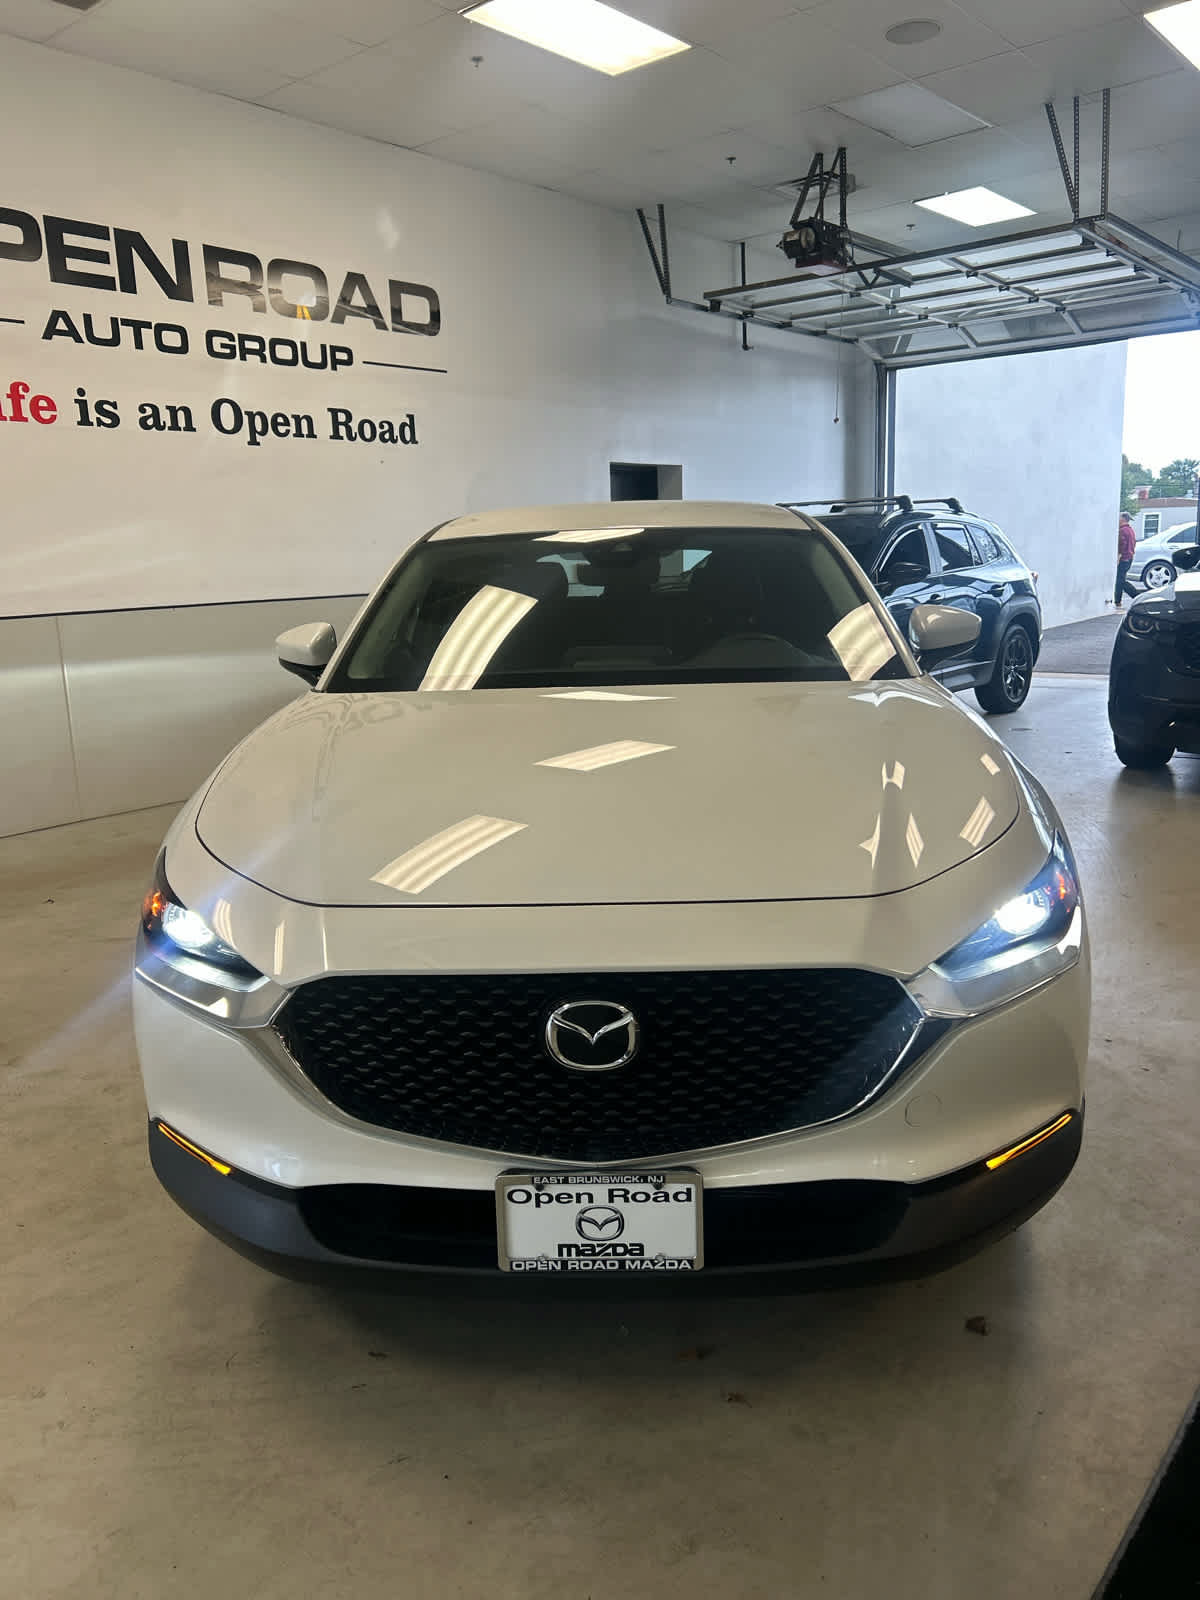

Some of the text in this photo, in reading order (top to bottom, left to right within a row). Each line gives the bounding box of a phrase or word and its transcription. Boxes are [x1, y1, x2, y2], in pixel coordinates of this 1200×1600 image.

[202, 244, 441, 337] ROAD
[42, 309, 354, 372] AUTO GROUP
[75, 388, 121, 428] is
[138, 402, 196, 433] an
[210, 398, 317, 446] Open
[327, 407, 418, 446] Road
[533, 1176, 565, 1185] EAST
[648, 1175, 664, 1184] NJ
[507, 1187, 692, 1208] Open Road
[557, 1243, 645, 1257] mazda
[512, 1259, 692, 1271] OPEN ROAD MAZDA
